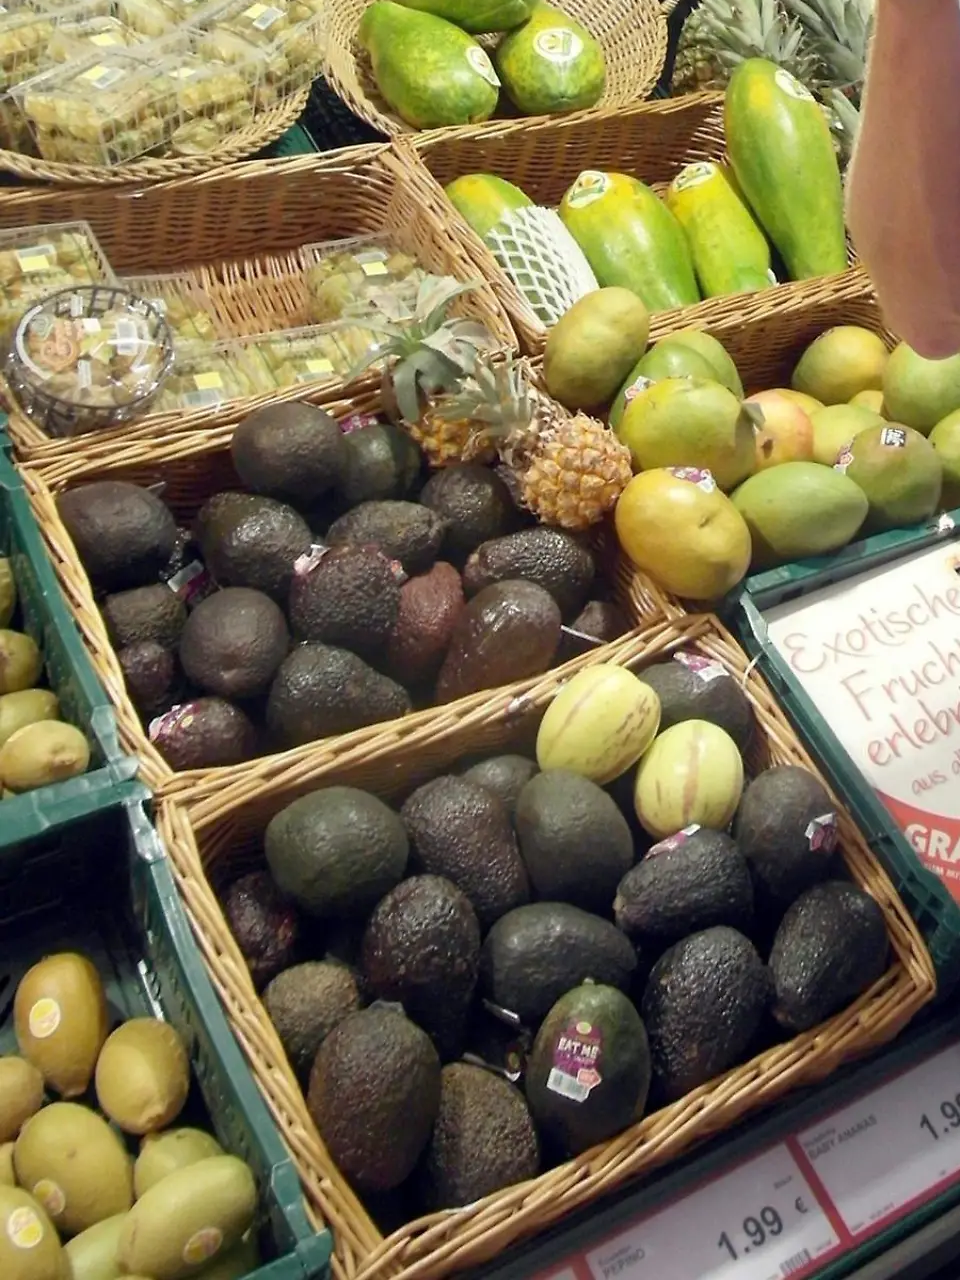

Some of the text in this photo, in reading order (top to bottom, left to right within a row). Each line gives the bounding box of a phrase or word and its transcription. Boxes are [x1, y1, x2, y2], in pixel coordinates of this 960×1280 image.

[911, 769, 949, 797] aus
[558, 1036, 581, 1055] EAT
[717, 1206, 783, 1261] 1.99
